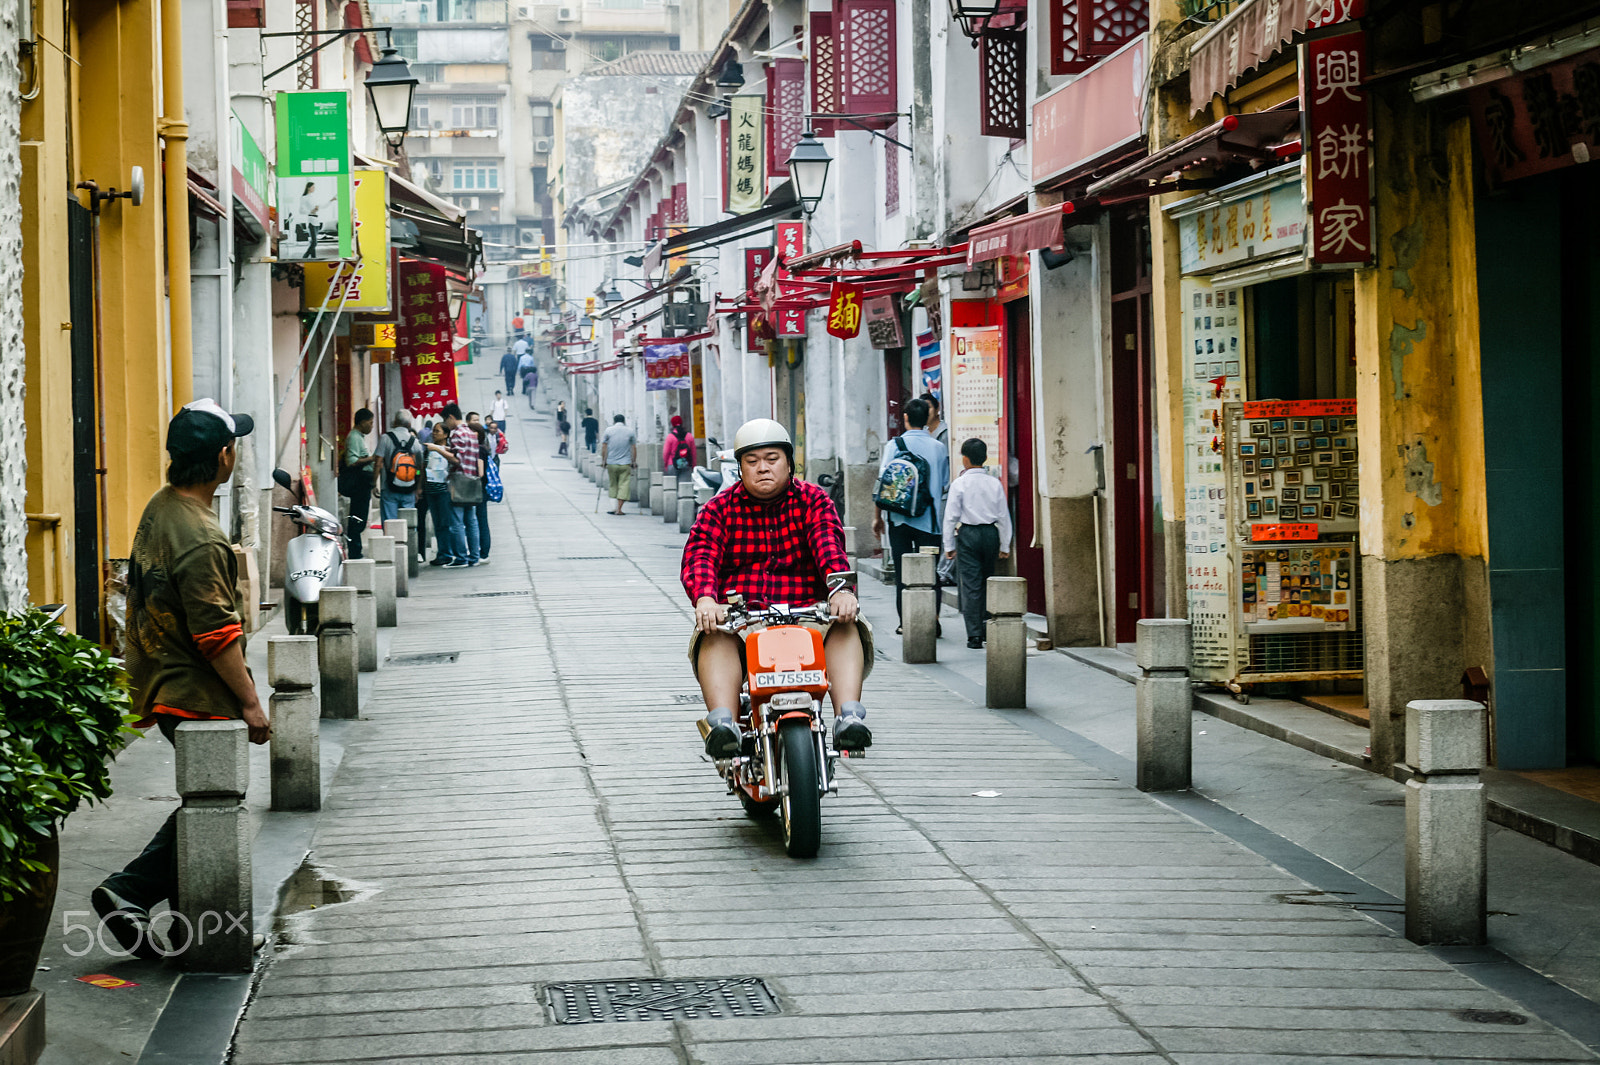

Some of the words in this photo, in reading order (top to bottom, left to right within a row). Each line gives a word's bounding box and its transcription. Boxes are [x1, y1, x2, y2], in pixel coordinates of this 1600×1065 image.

[737, 112, 755, 195] 火龍媽媽
[406, 272, 442, 386] 譚家魚翅飯店
[758, 674, 775, 685] CM
[778, 672, 821, 684] 75555
